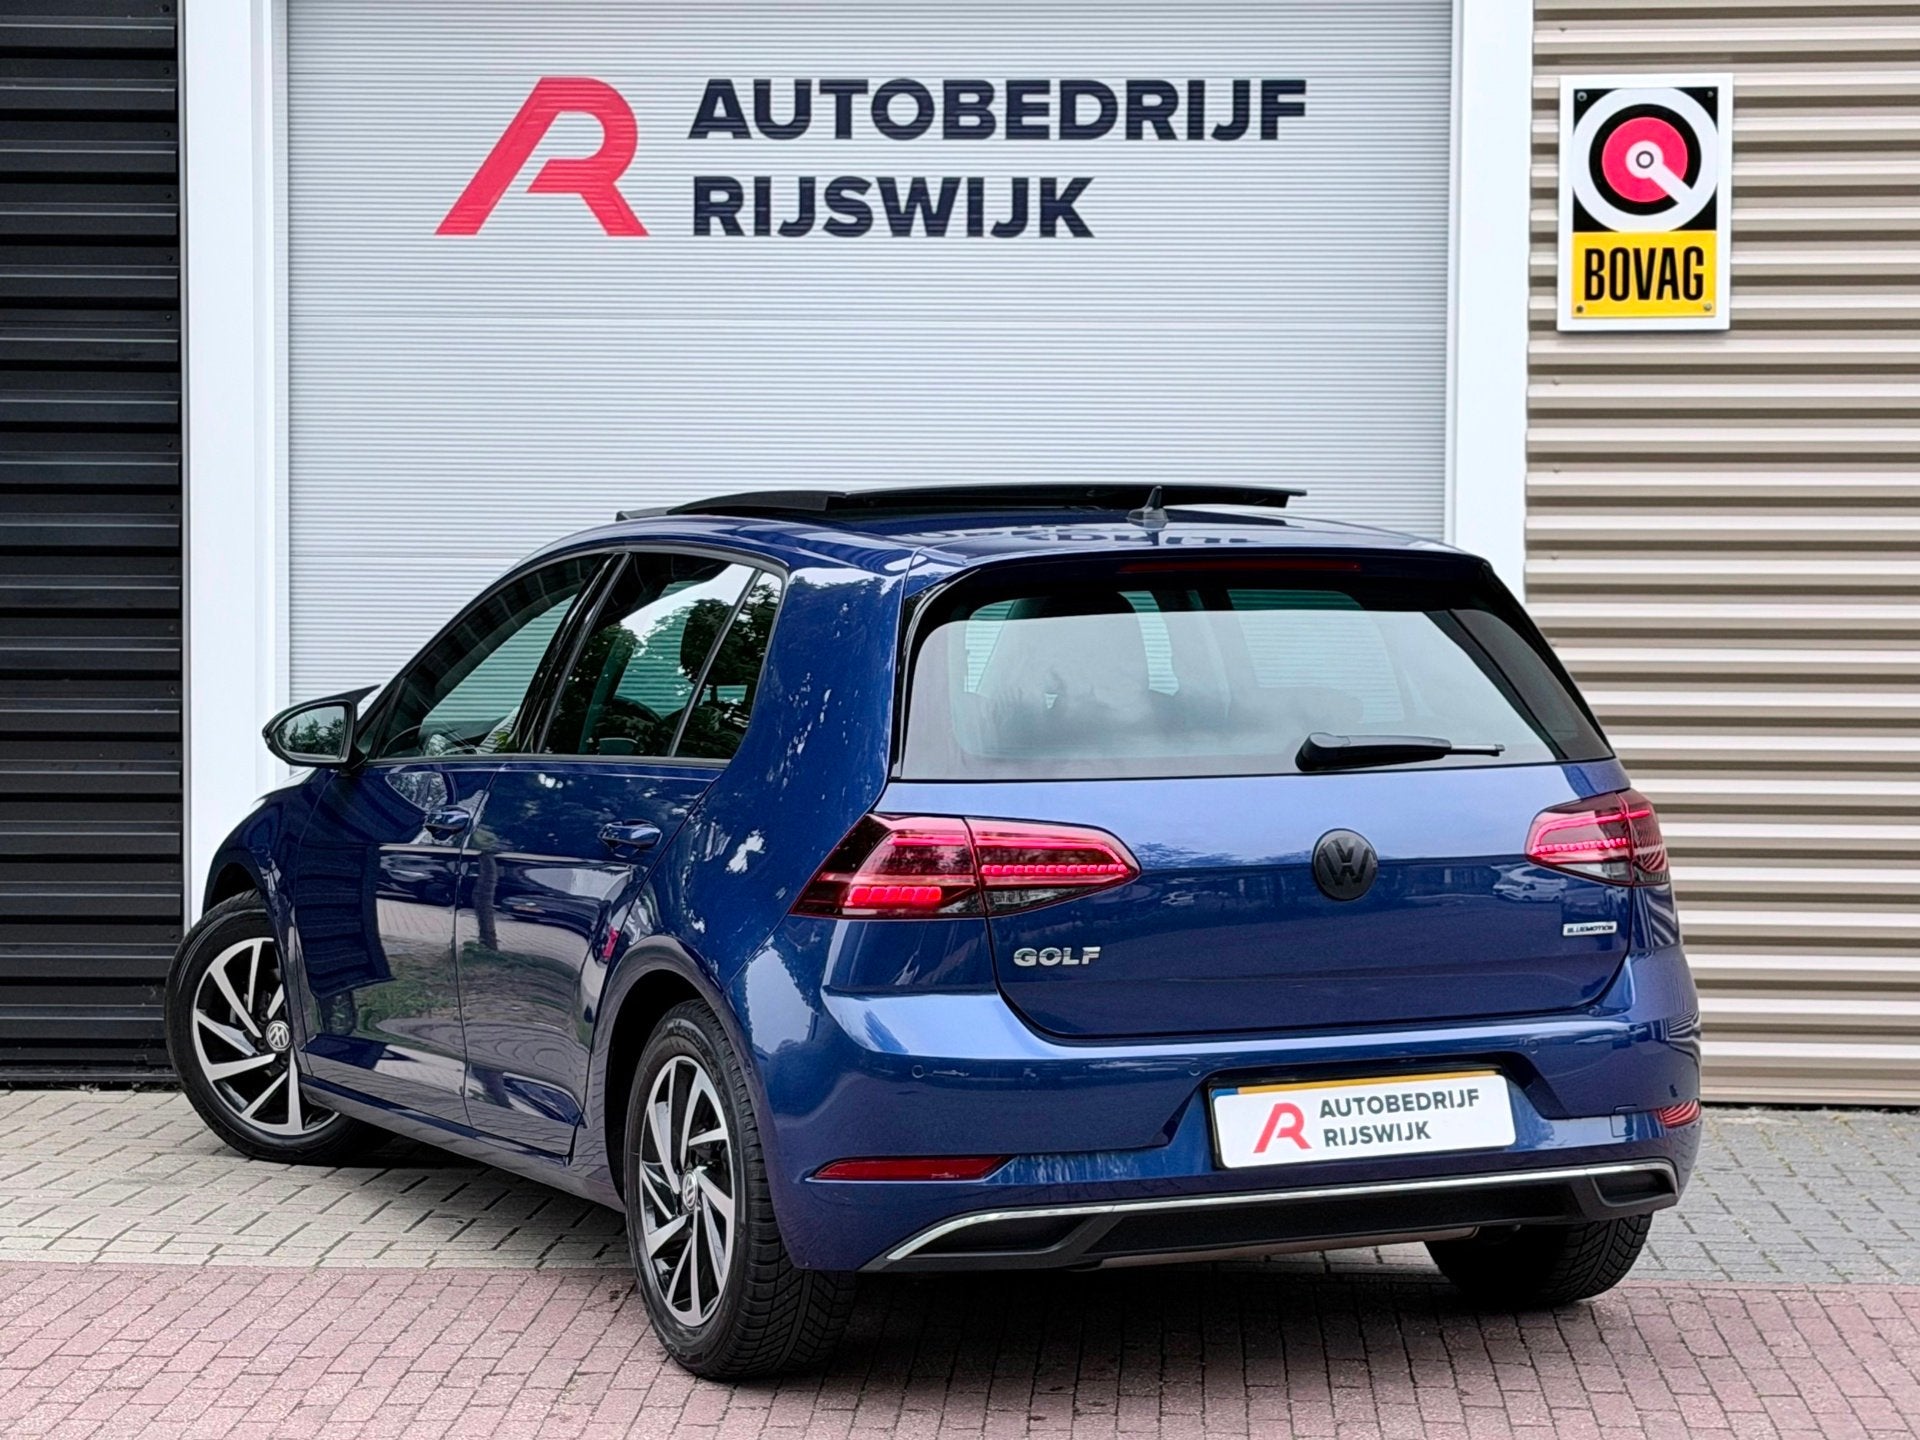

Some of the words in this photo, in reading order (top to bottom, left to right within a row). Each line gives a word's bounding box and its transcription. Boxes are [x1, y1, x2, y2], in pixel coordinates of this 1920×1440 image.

[687, 78, 1307, 141] AUTOBEDRIJF
[692, 175, 1095, 239] RIJSWIJK
[1583, 245, 1705, 301] BOVAG
[1013, 946, 1101, 967] GOLF
[1319, 1088, 1479, 1119] AUTOBEDRIJF
[1323, 1121, 1432, 1148] RIJSWIJK
